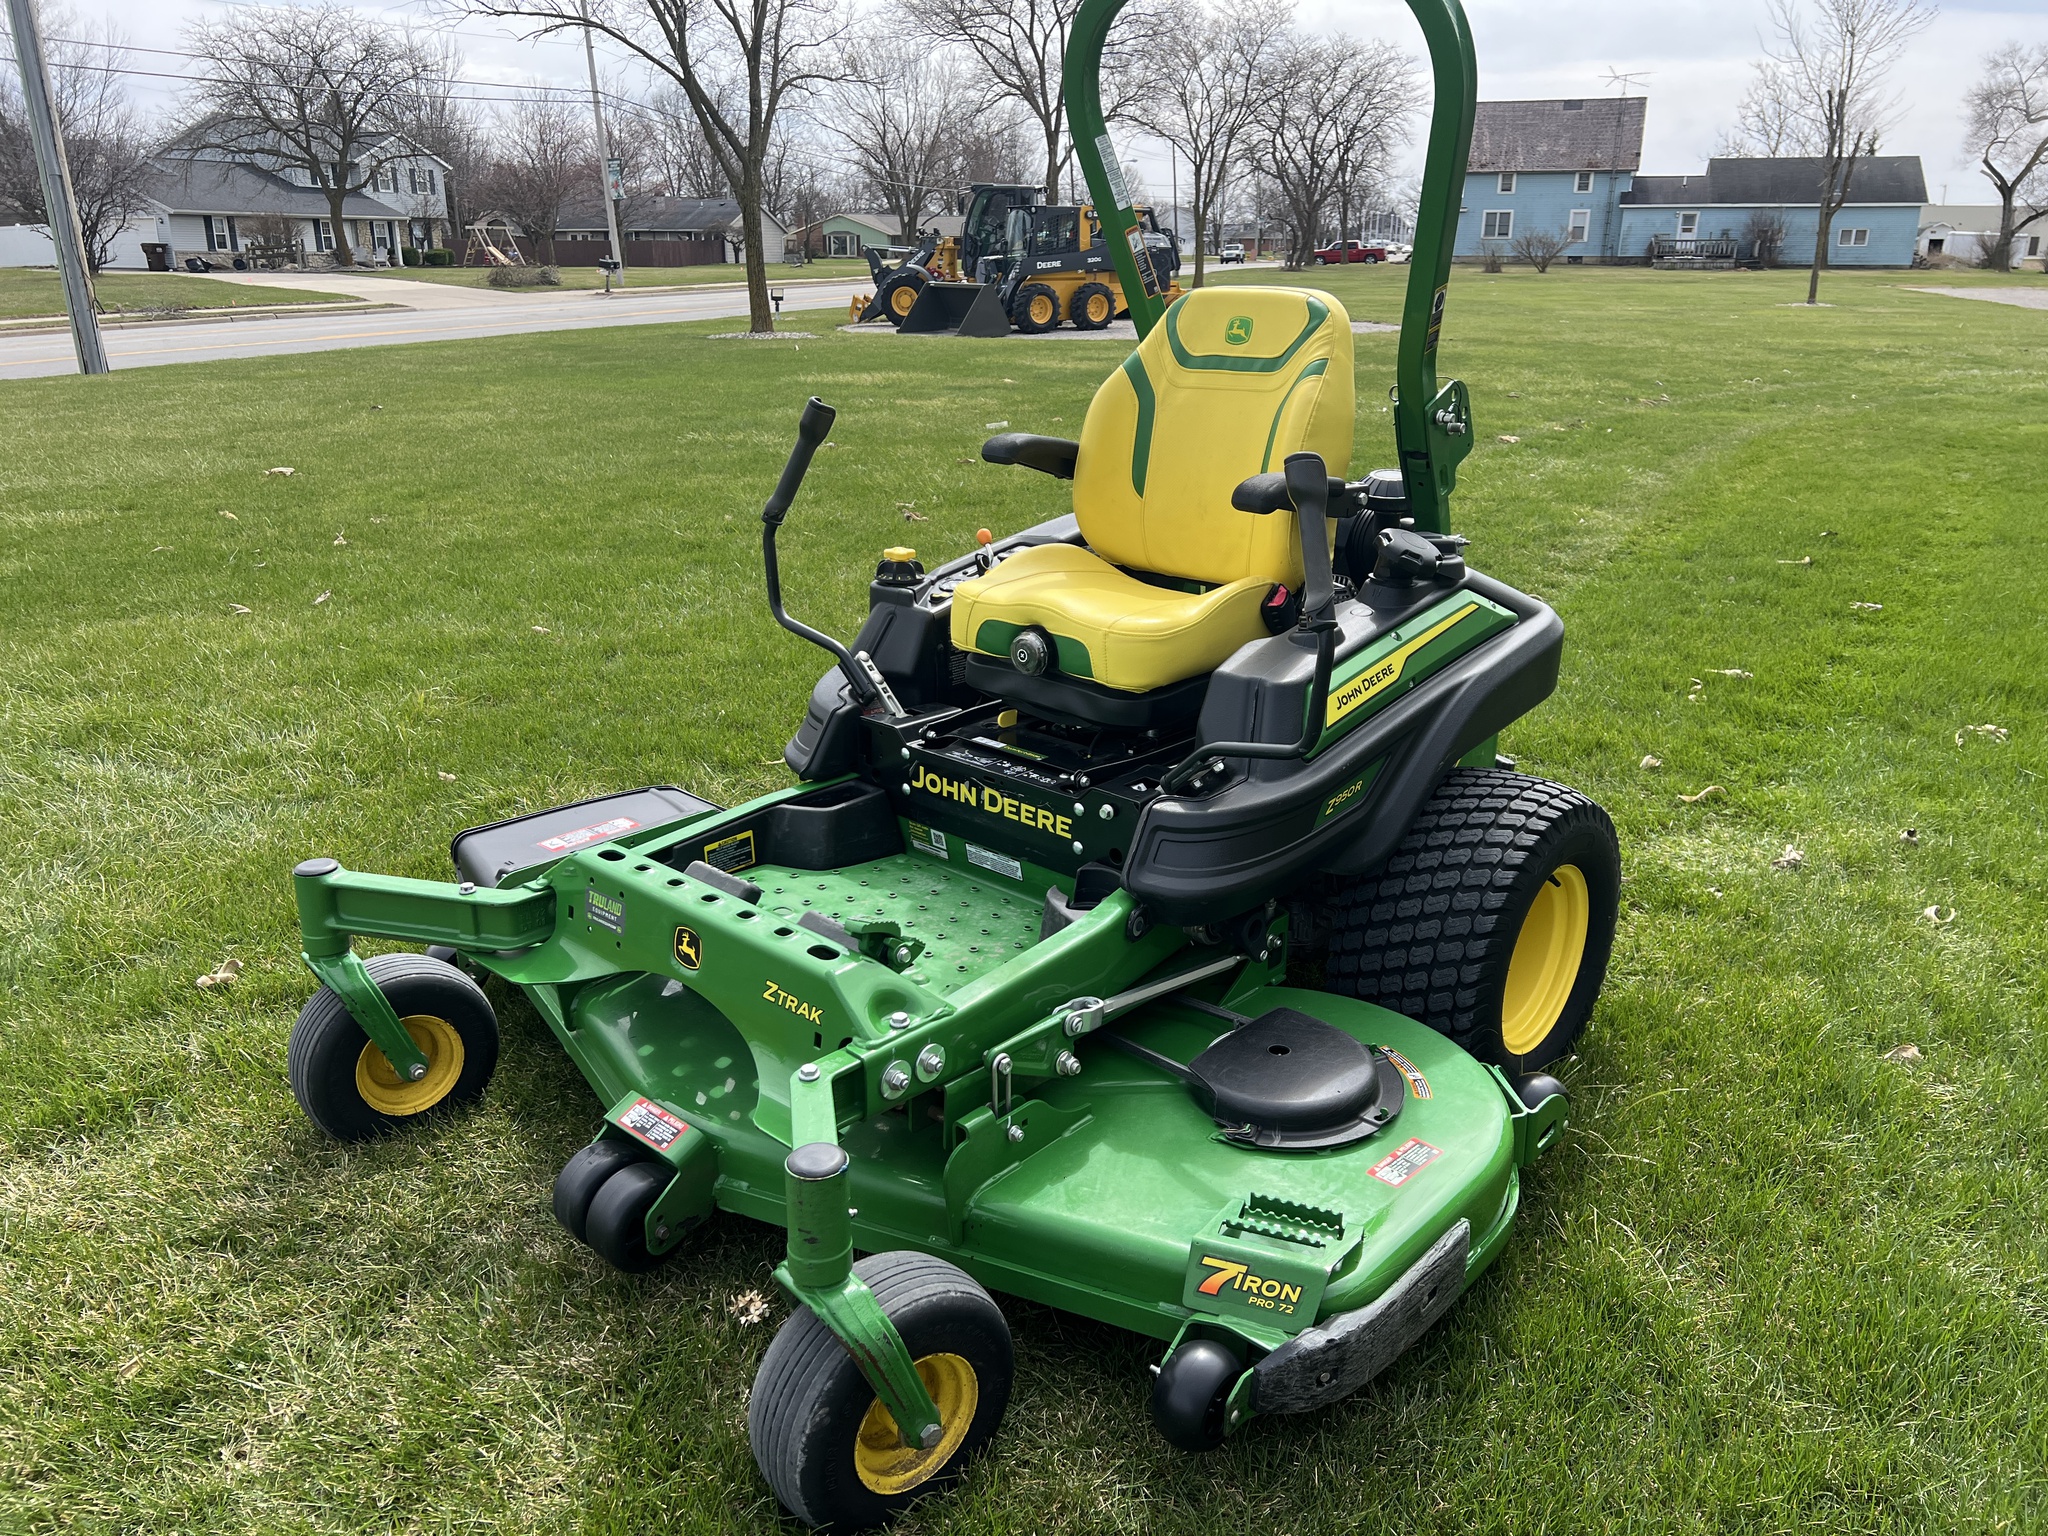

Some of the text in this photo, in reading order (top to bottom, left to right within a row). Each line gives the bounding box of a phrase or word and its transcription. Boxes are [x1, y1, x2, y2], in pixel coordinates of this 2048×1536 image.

[1036, 260, 1062, 269] DEERE
[1336, 663, 1395, 710] JOHN DEERE
[911, 765, 977, 807] JOHN
[983, 787, 1073, 839] DEERE
[1325, 780, 1363, 816] Z950R
[588, 890, 623, 917] TRULAND
[762, 980, 824, 1025] ZTRAK
[1248, 1296, 1294, 1315] PRO 72
